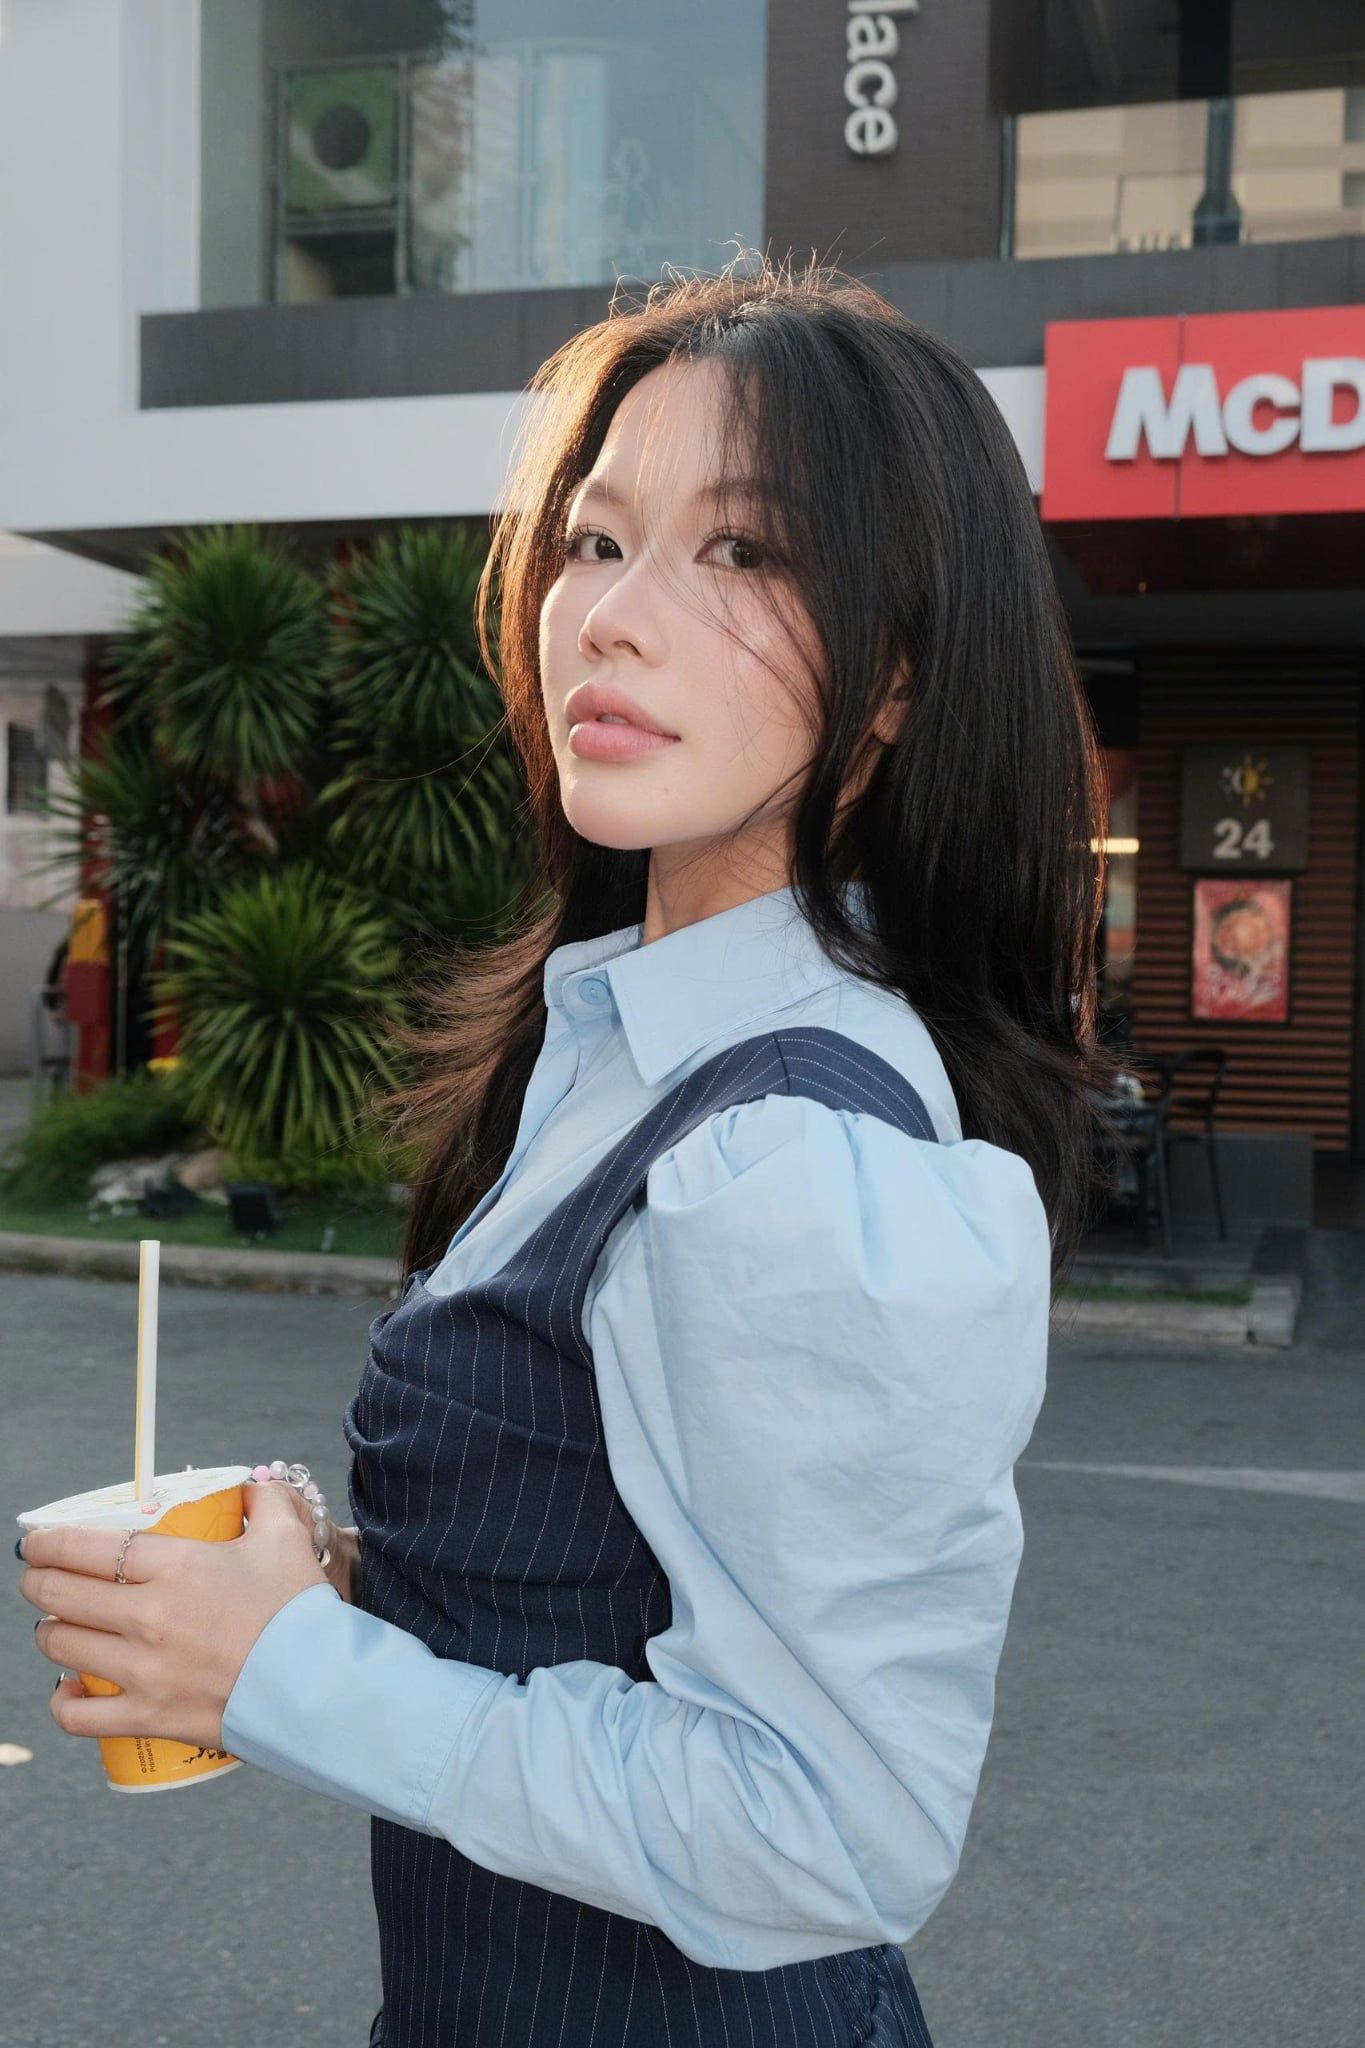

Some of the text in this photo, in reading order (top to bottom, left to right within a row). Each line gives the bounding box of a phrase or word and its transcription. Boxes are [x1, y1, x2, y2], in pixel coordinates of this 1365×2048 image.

[845, 0, 918, 153] lace
[1105, 358, 1365, 460] McD
[1213, 819, 1274, 859] 24
[146, 1748, 156, 1773] Printed
